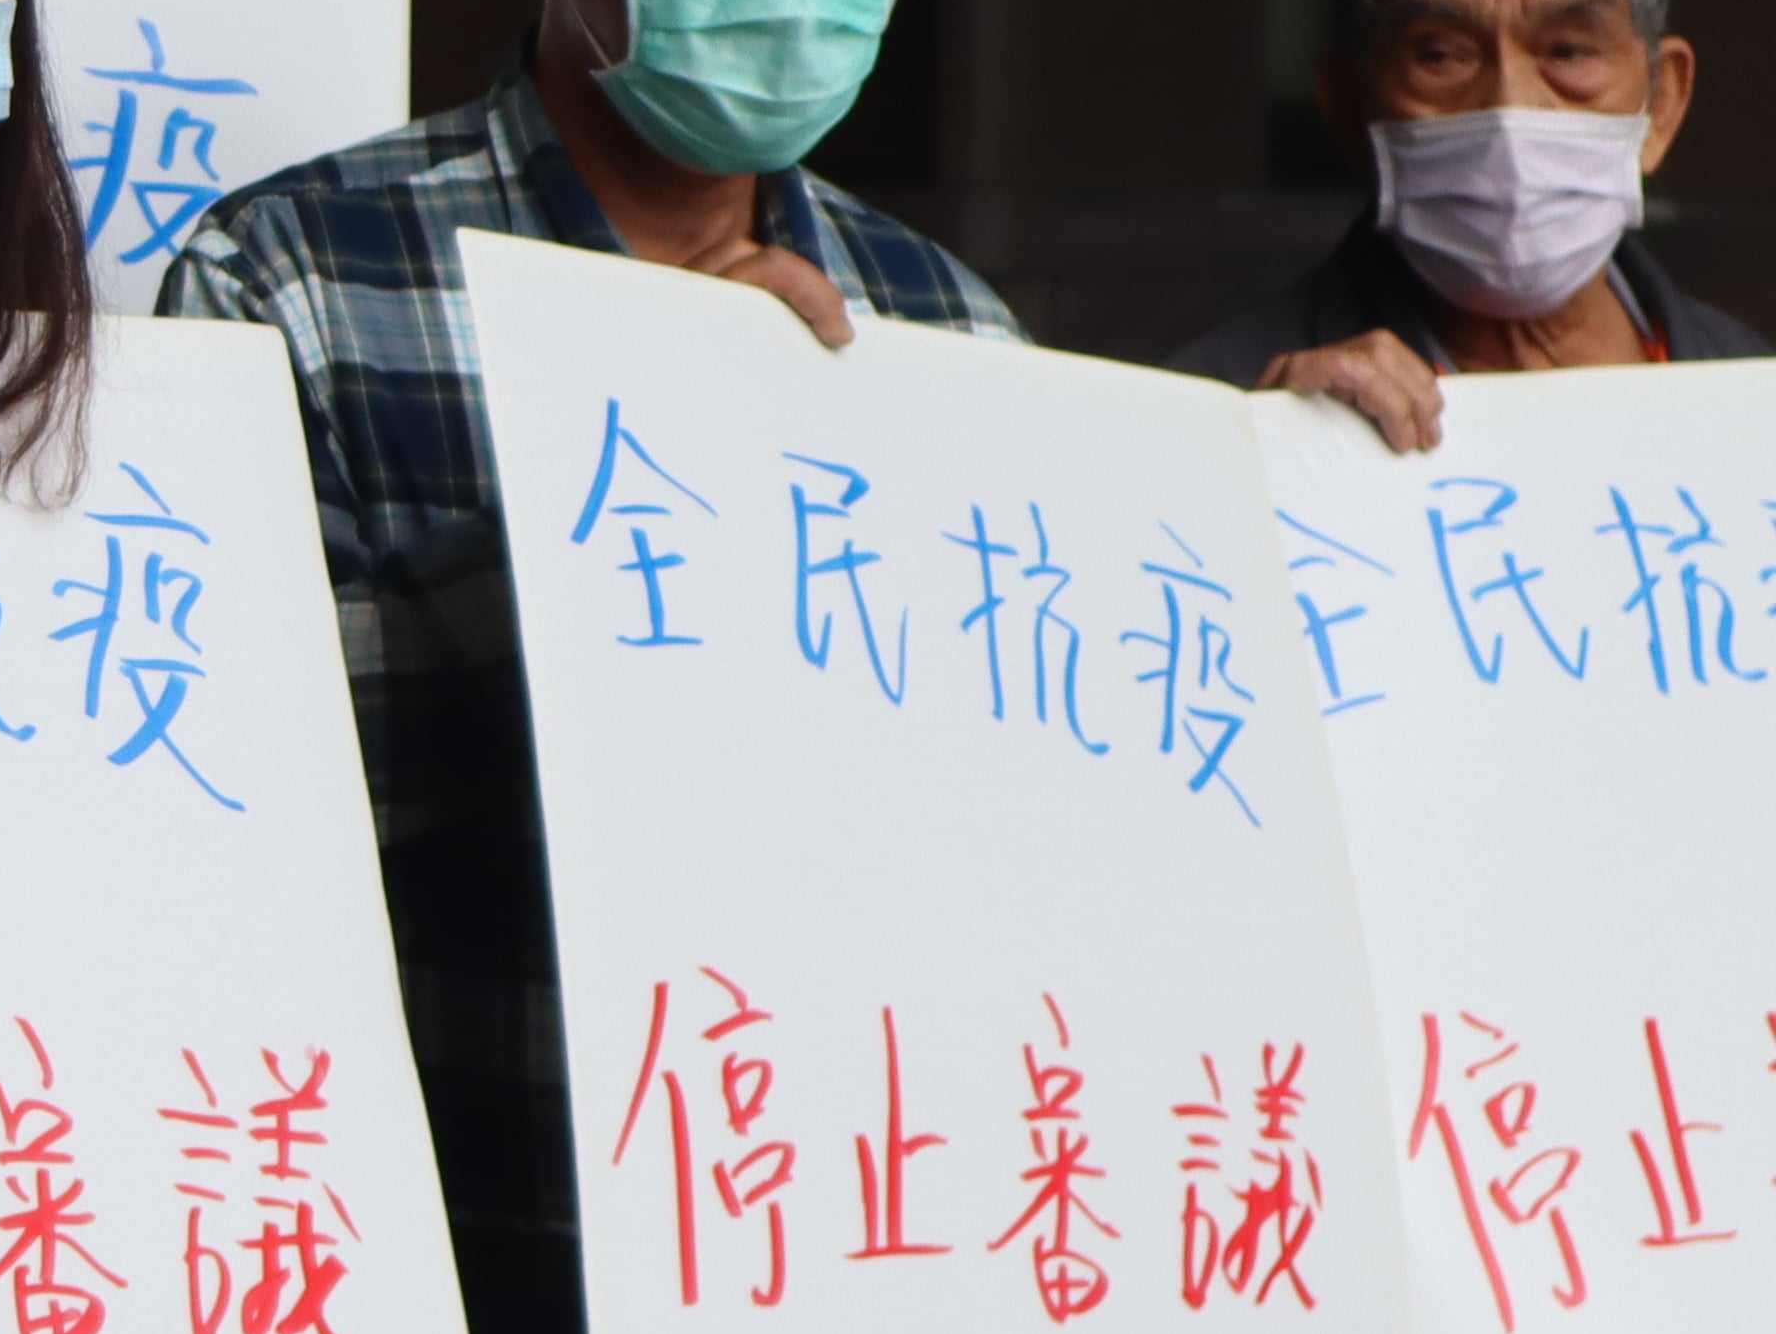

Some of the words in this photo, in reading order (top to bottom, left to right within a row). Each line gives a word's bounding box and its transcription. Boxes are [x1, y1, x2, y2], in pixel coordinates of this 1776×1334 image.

[569, 397, 1261, 827] 全民抗疫
[1274, 477, 1776, 715] 全民抗
[612, 967, 1324, 1325] 停止審議
[1408, 1011, 1776, 1334] 停止
